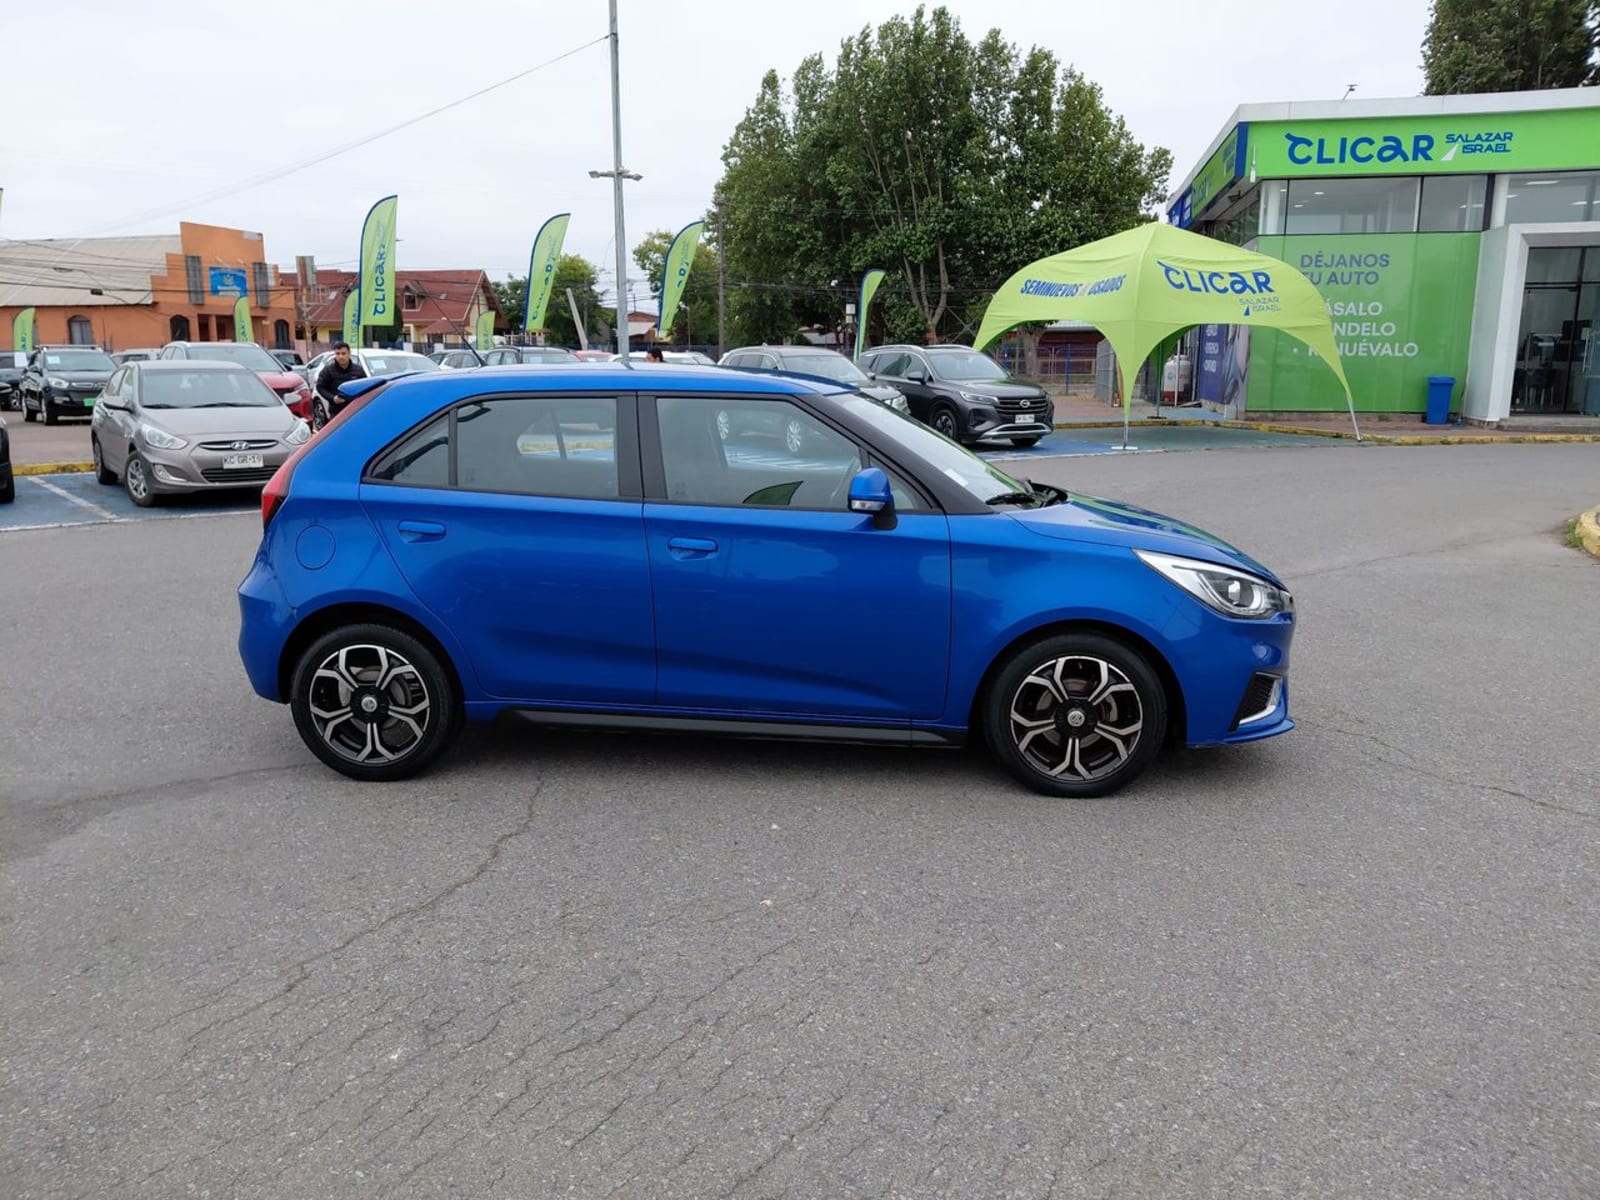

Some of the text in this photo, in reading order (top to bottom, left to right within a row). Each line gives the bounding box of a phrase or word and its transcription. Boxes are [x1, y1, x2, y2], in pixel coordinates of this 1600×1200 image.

[1445, 132, 1513, 144] SALAZAR
[1462, 143, 1513, 154] ISRAEL
[1300, 250, 1390, 268] DÉJANOS
[1326, 271, 1379, 286] AUTO
[1020, 279, 1083, 297] SEMINUEVOS
[1239, 297, 1281, 306] SALAZAR
